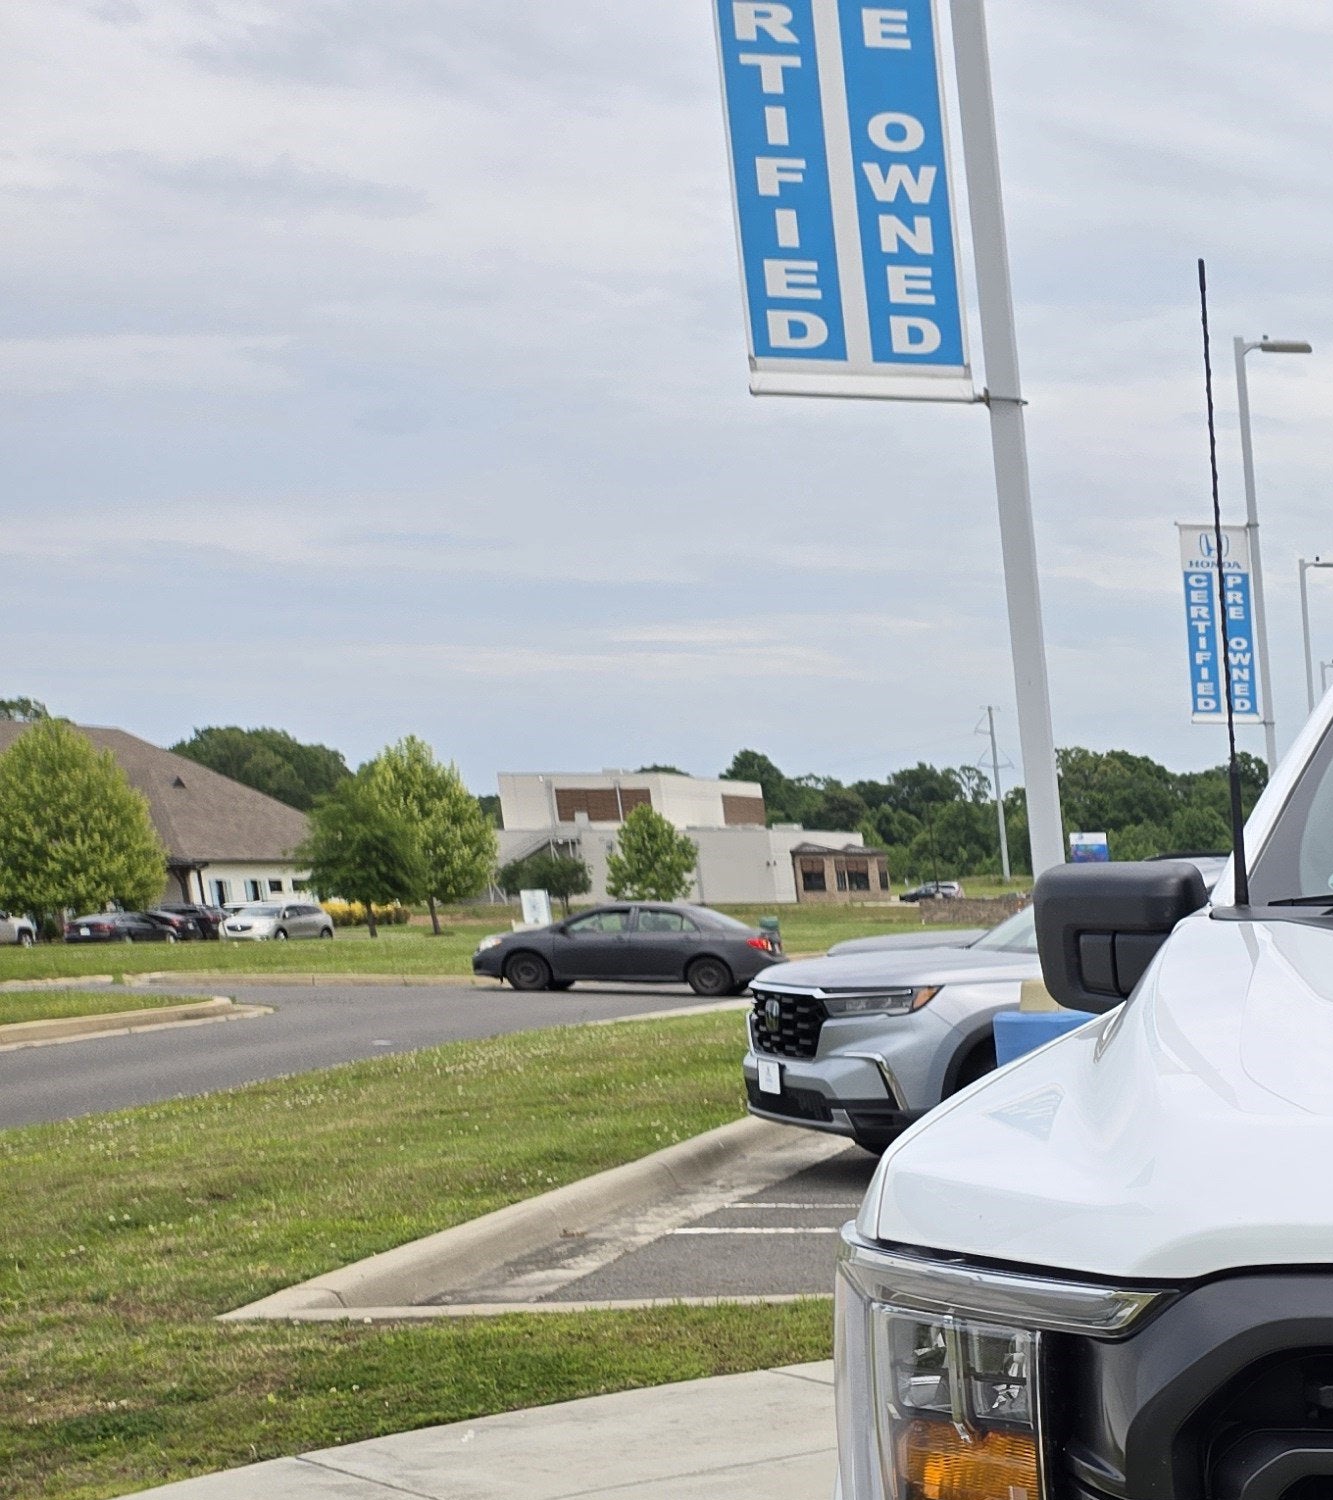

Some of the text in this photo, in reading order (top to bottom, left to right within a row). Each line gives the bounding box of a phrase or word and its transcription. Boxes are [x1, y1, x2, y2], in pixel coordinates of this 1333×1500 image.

[861, 112, 943, 355] OWNED
[1188, 575, 1217, 711] CERTIFIED
[1226, 575, 1252, 711] PRE OWNED
